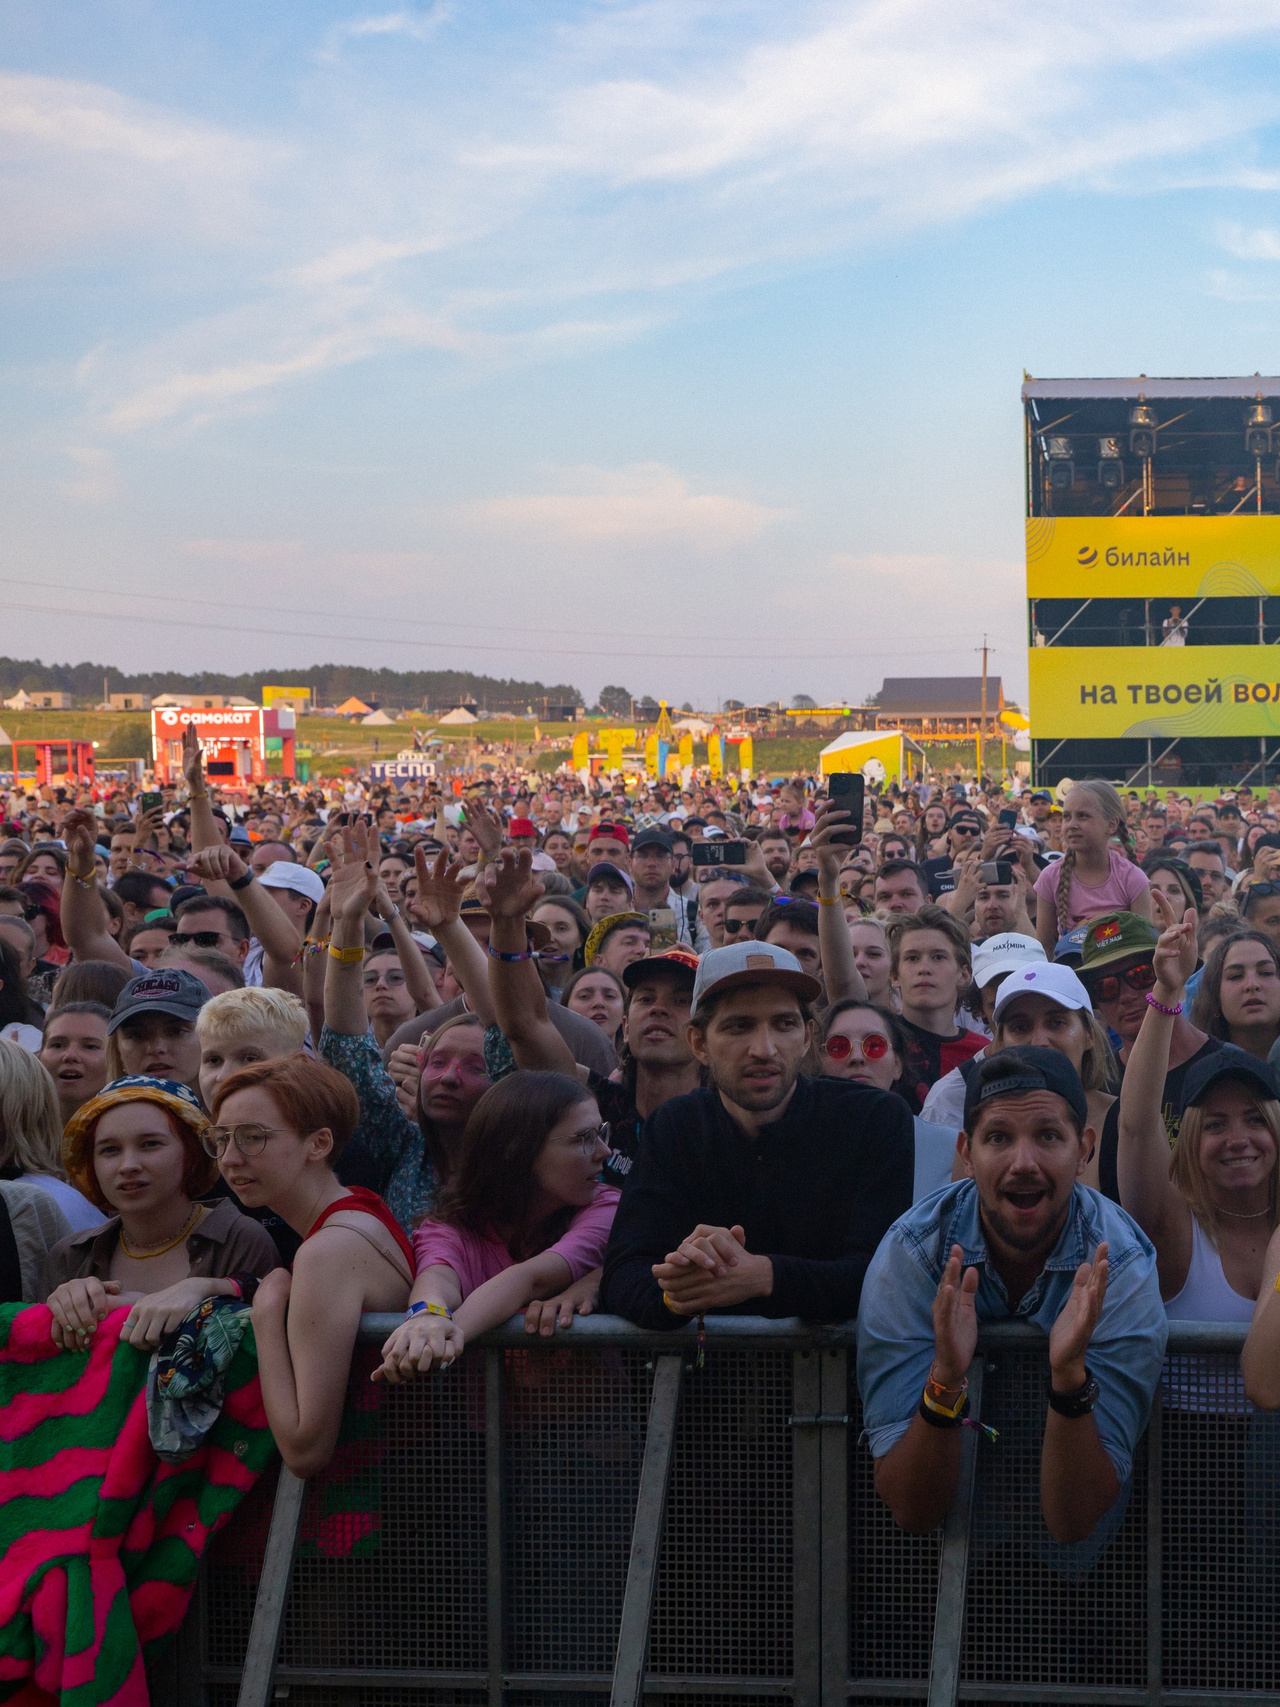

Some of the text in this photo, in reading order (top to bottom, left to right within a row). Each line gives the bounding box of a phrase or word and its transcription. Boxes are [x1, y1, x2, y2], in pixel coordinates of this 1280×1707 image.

[1105, 546, 1190, 566] билайн
[1080, 684, 1117, 704] на
[1127, 678, 1222, 704] твоей
[371, 763, 435, 777] TECNO
[131, 978, 180, 996] CHICAGO
